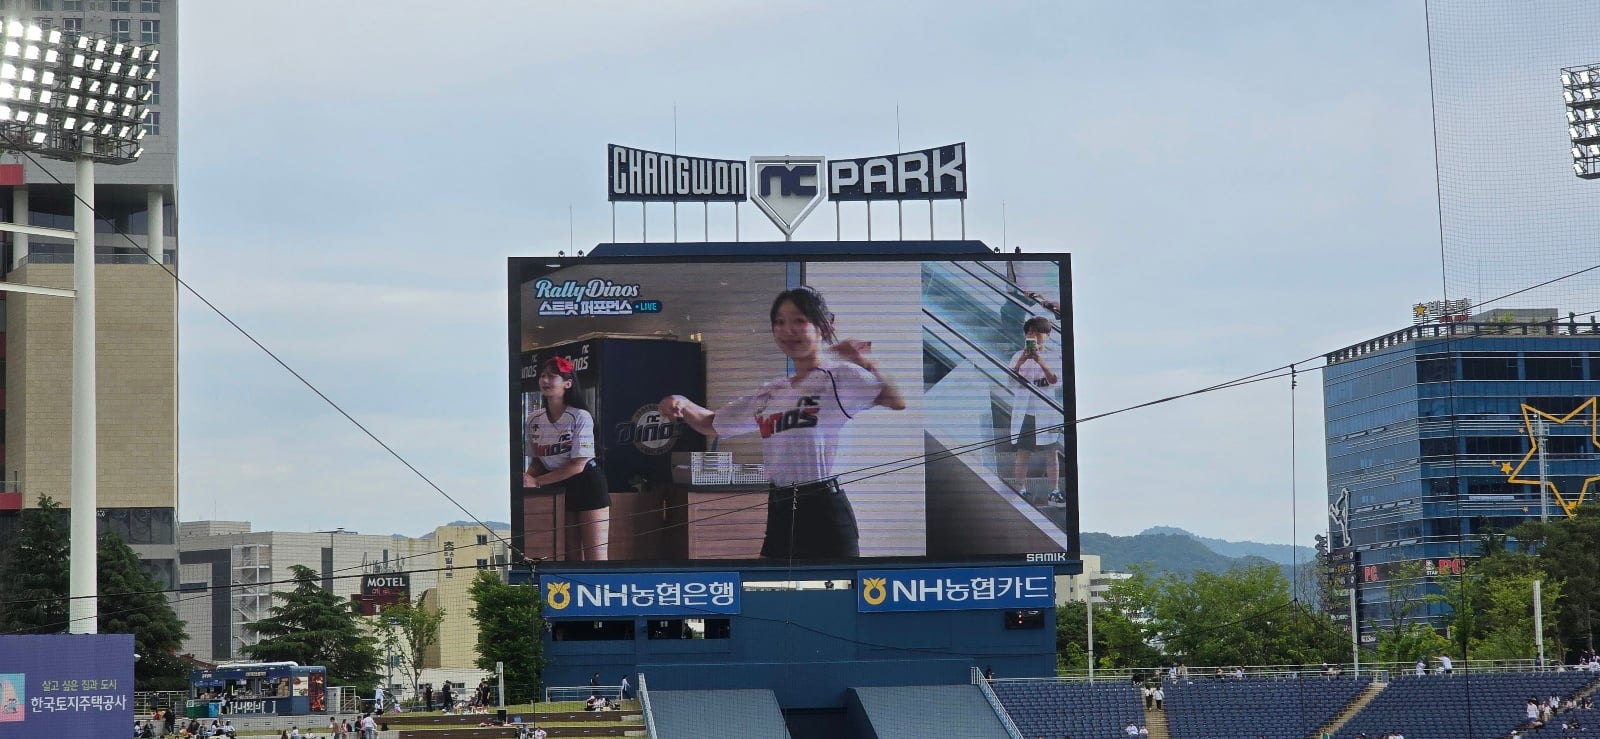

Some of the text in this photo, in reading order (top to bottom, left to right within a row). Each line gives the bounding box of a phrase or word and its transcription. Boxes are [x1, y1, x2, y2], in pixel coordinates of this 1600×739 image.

[613, 146, 746, 196] CHANGWON
[831, 144, 965, 194] PARK
[539, 300, 633, 315] 스트릿 퍼포먼스
[640, 302, 657, 311] LIVE
[1026, 552, 1067, 562] SAMIK
[367, 577, 406, 587] MOTEL
[892, 576, 1049, 602] NH농협카드
[577, 580, 735, 607] NH농협은행
[42, 679, 117, 692] 살고 싶은 집과 도시
[31, 694, 127, 712] 한국토지주택공사
